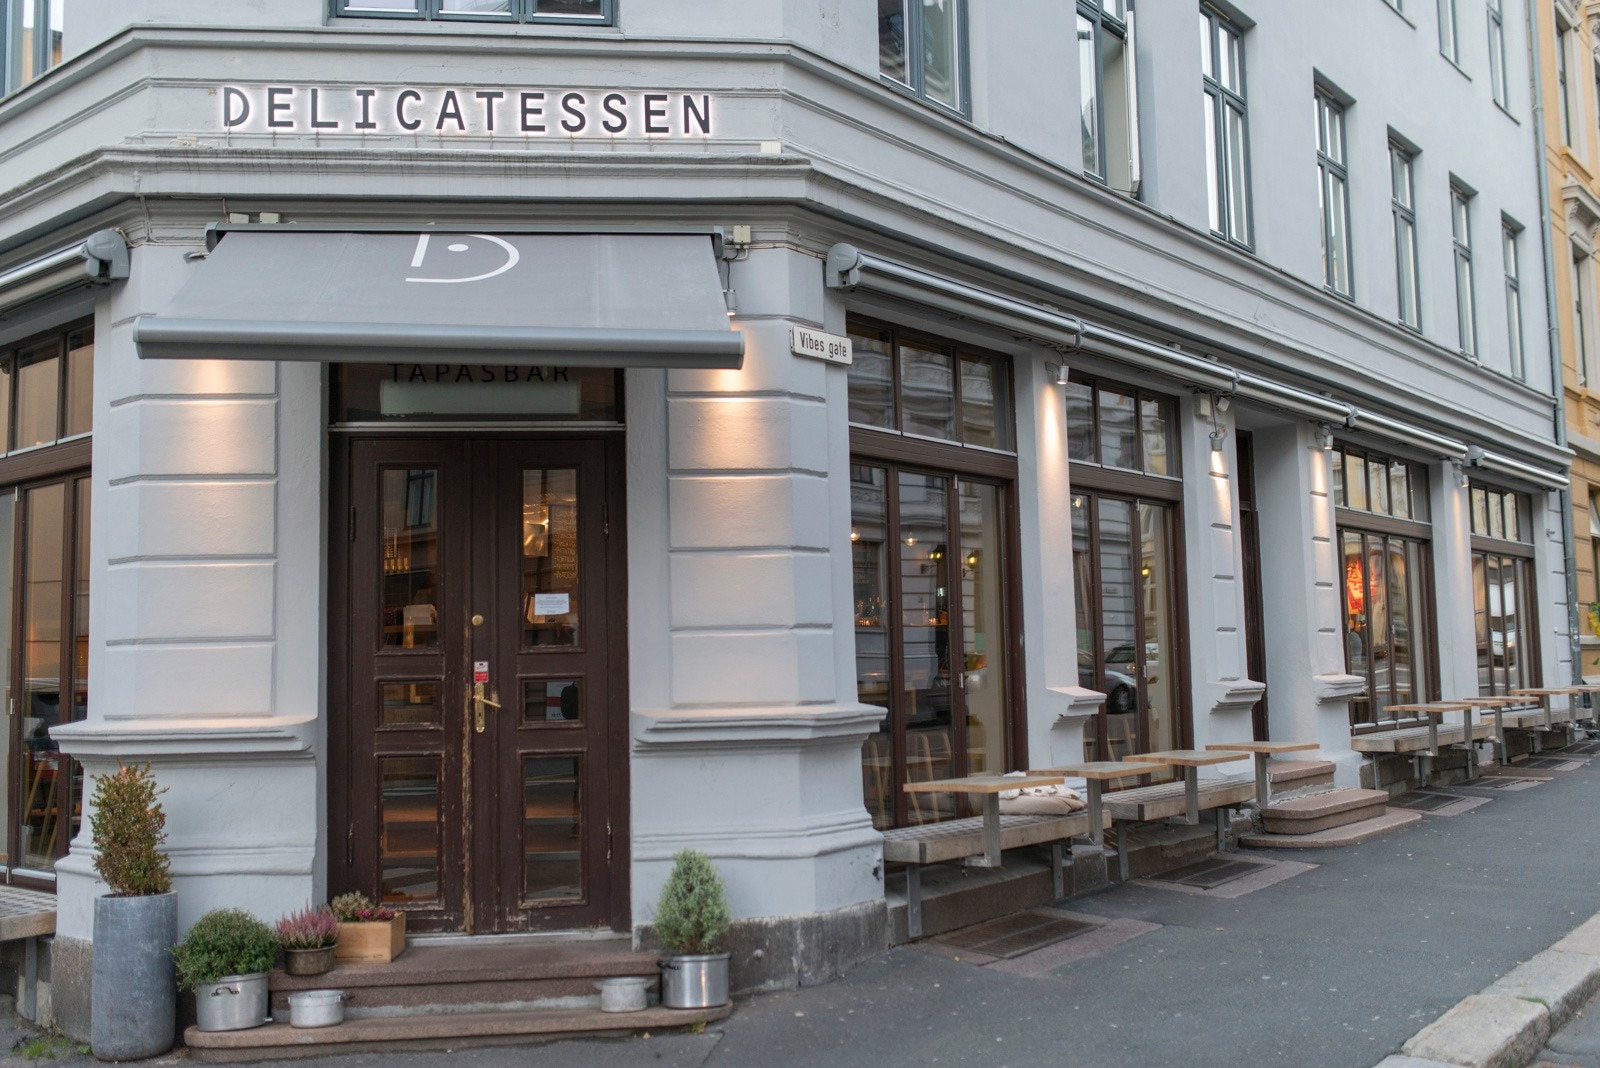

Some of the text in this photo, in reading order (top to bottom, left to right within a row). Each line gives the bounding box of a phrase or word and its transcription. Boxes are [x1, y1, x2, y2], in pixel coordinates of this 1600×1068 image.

[223, 86, 711, 135] DELICATESSEN
[799, 331, 847, 359] Vibes gate
[387, 362, 570, 383] TAPASBAR
